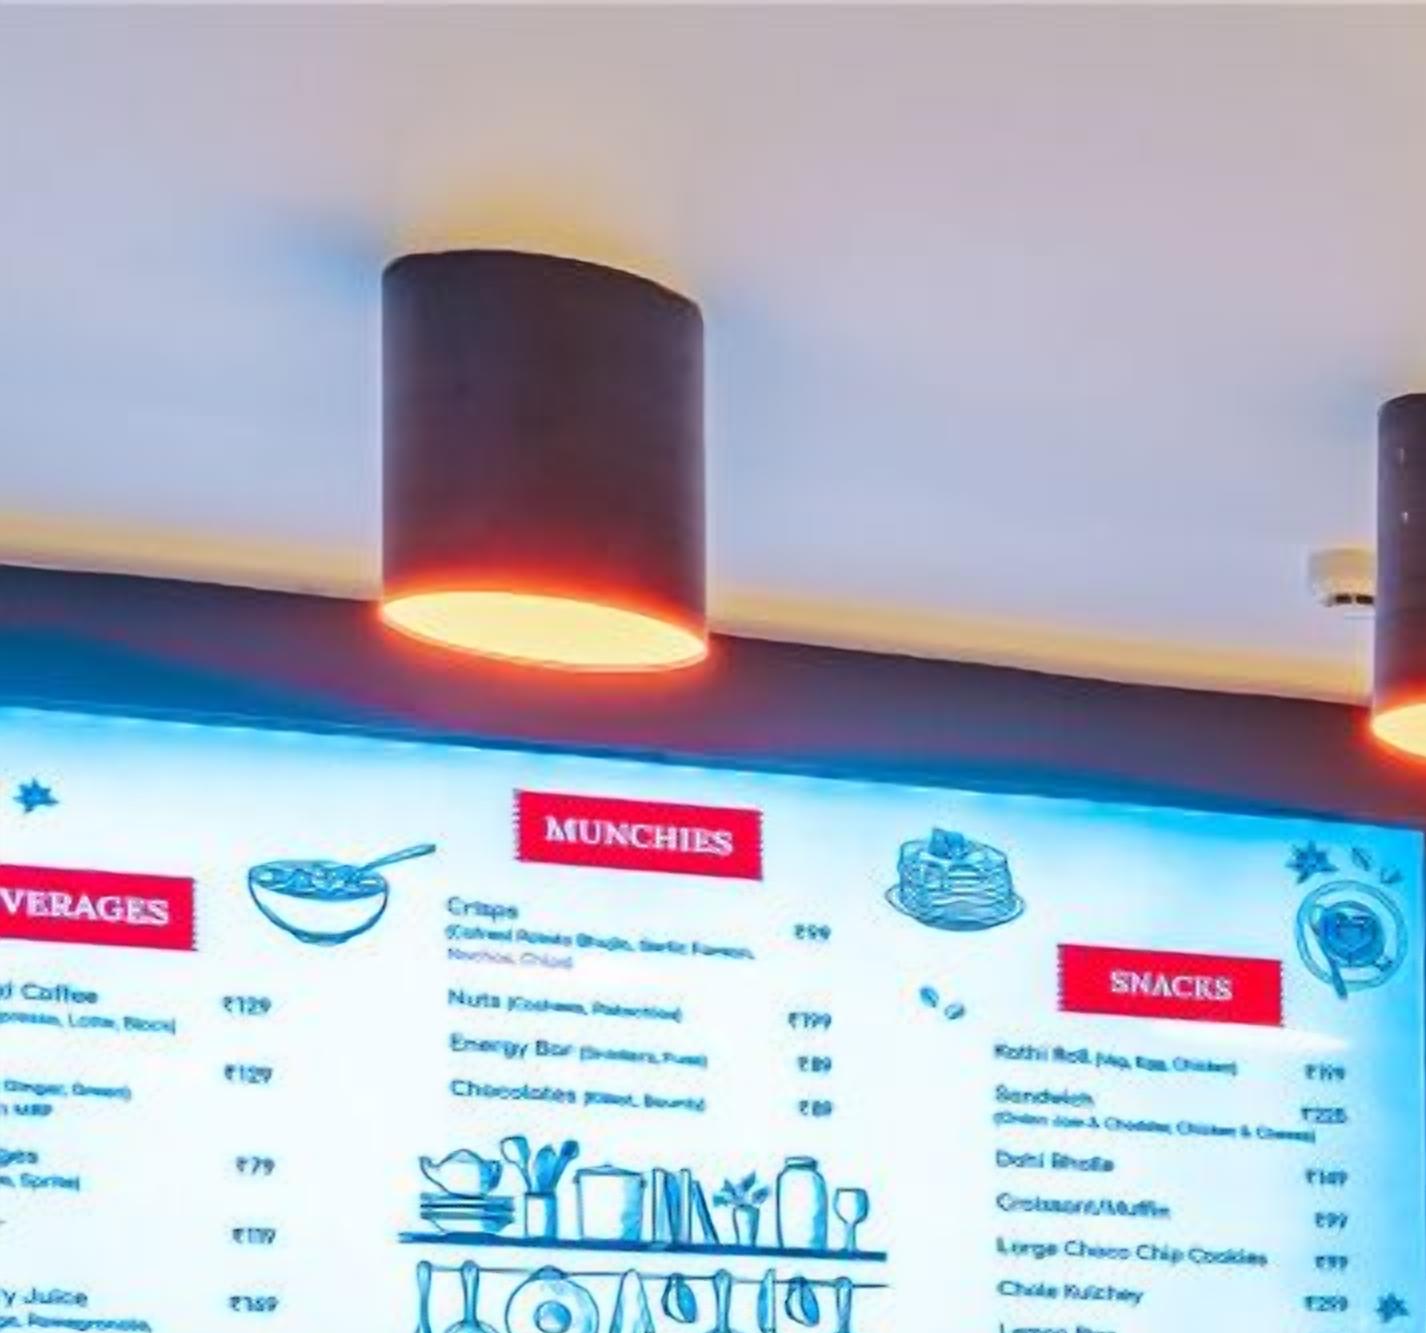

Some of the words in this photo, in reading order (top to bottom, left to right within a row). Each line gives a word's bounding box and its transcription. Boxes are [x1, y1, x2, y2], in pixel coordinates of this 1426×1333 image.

[546, 816, 733, 856] MUNCHIES
[0, 887, 169, 926] VERAGES
[20, 983, 98, 1004] Coffee
[1110, 970, 1232, 1001] SNACKS
[449, 1033, 528, 1059] Energy
[535, 1040, 573, 1057] Bar
[449, 1079, 577, 1104] Chocolates
[996, 1238, 1058, 1259] Large
[1063, 1240, 1131, 1260] Choco
[1135, 1244, 1185, 1264] Chip
[1187, 1248, 1268, 1266] Cookies
[23, 1288, 88, 1307] Juice
